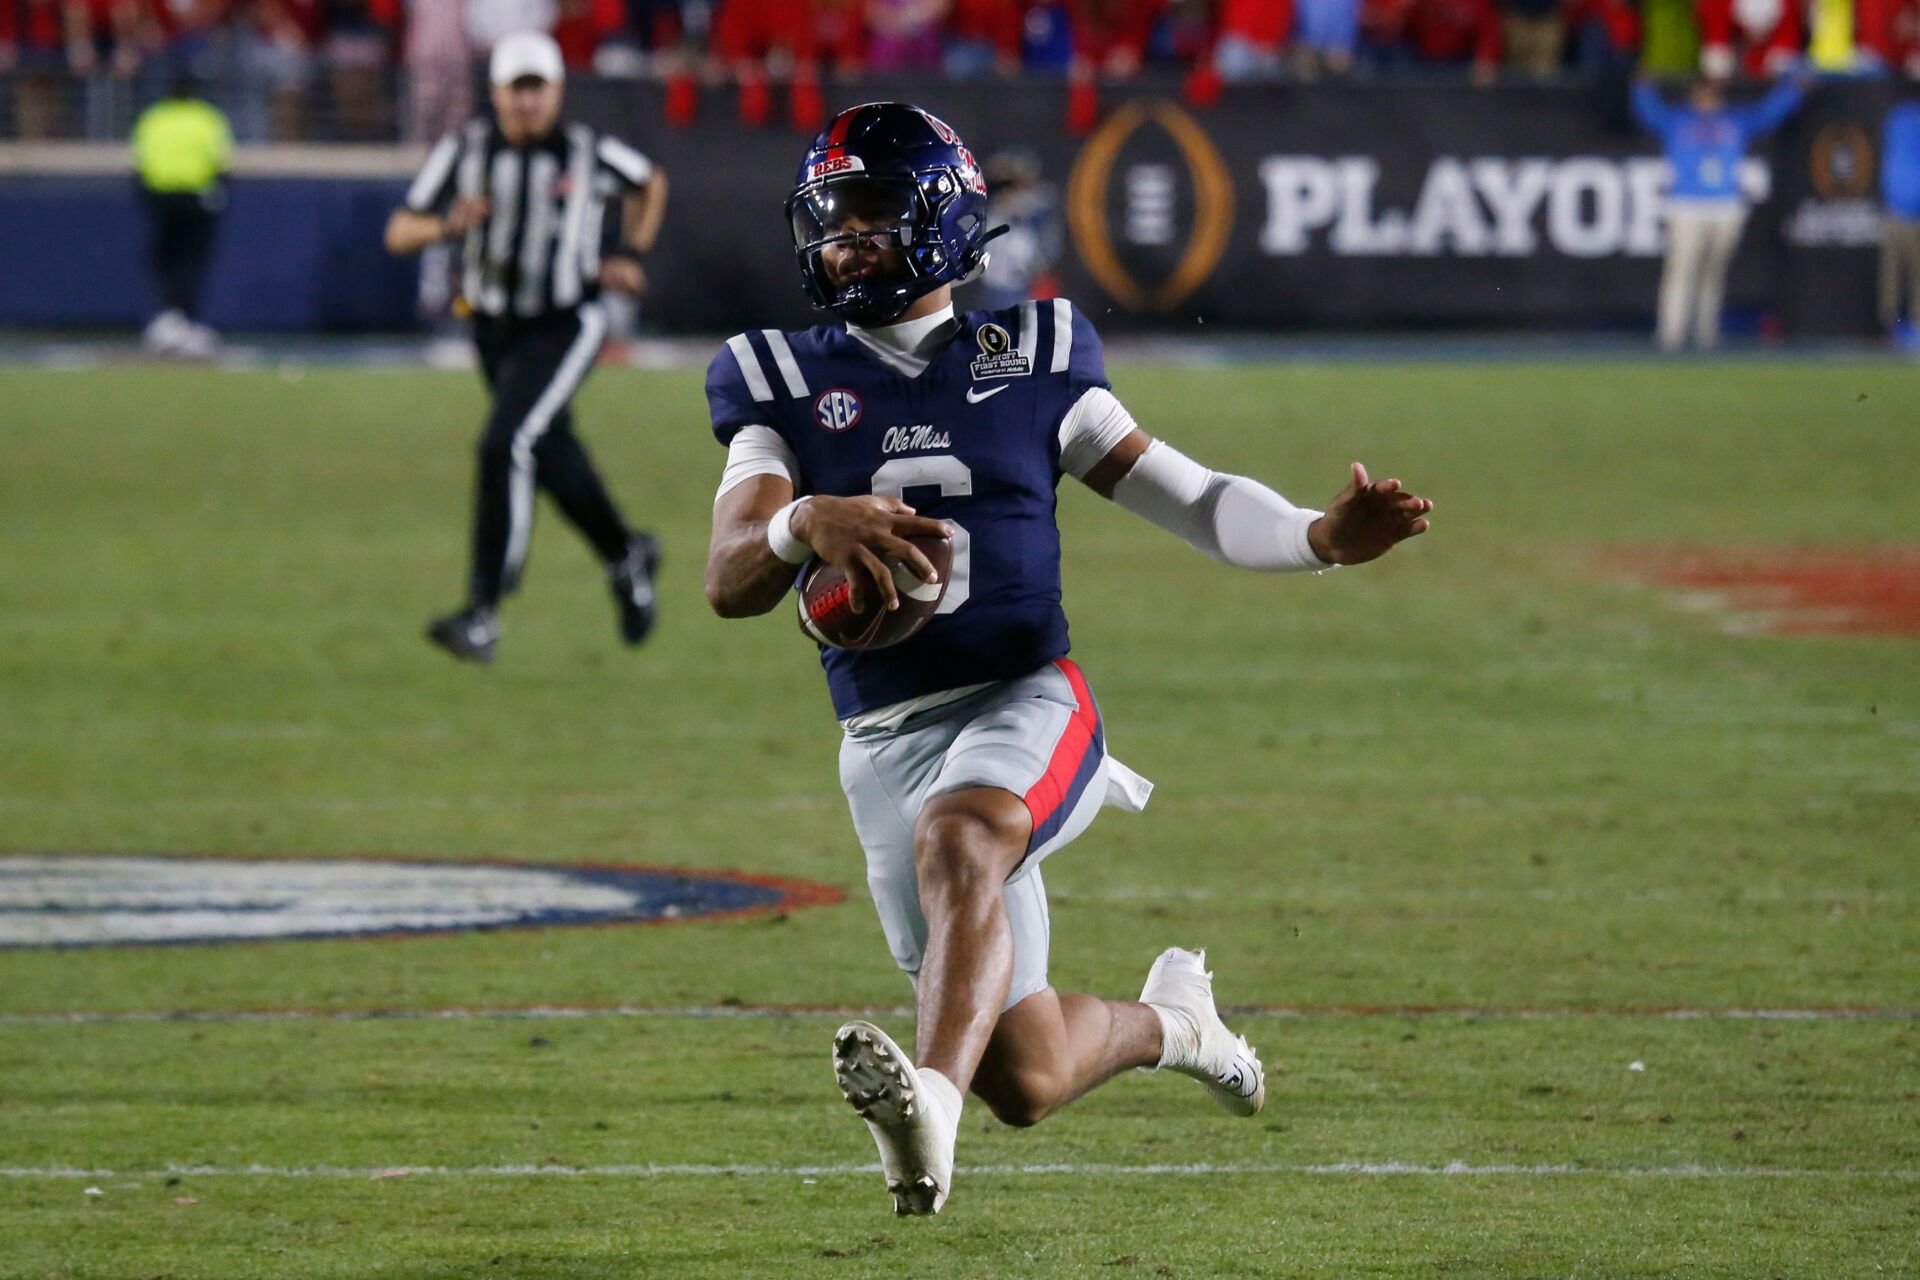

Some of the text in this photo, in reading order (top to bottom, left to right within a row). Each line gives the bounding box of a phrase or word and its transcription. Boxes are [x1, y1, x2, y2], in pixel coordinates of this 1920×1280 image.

[813, 156, 852, 177] REBS
[1259, 154, 1771, 258] PLAYOF
[974, 361, 998, 371] FIRST
[1000, 358, 1027, 367] ROUND
[981, 352, 1017, 362] PLAYOFF
[817, 390, 858, 430] SEC
[882, 425, 951, 453] Ole Miss
